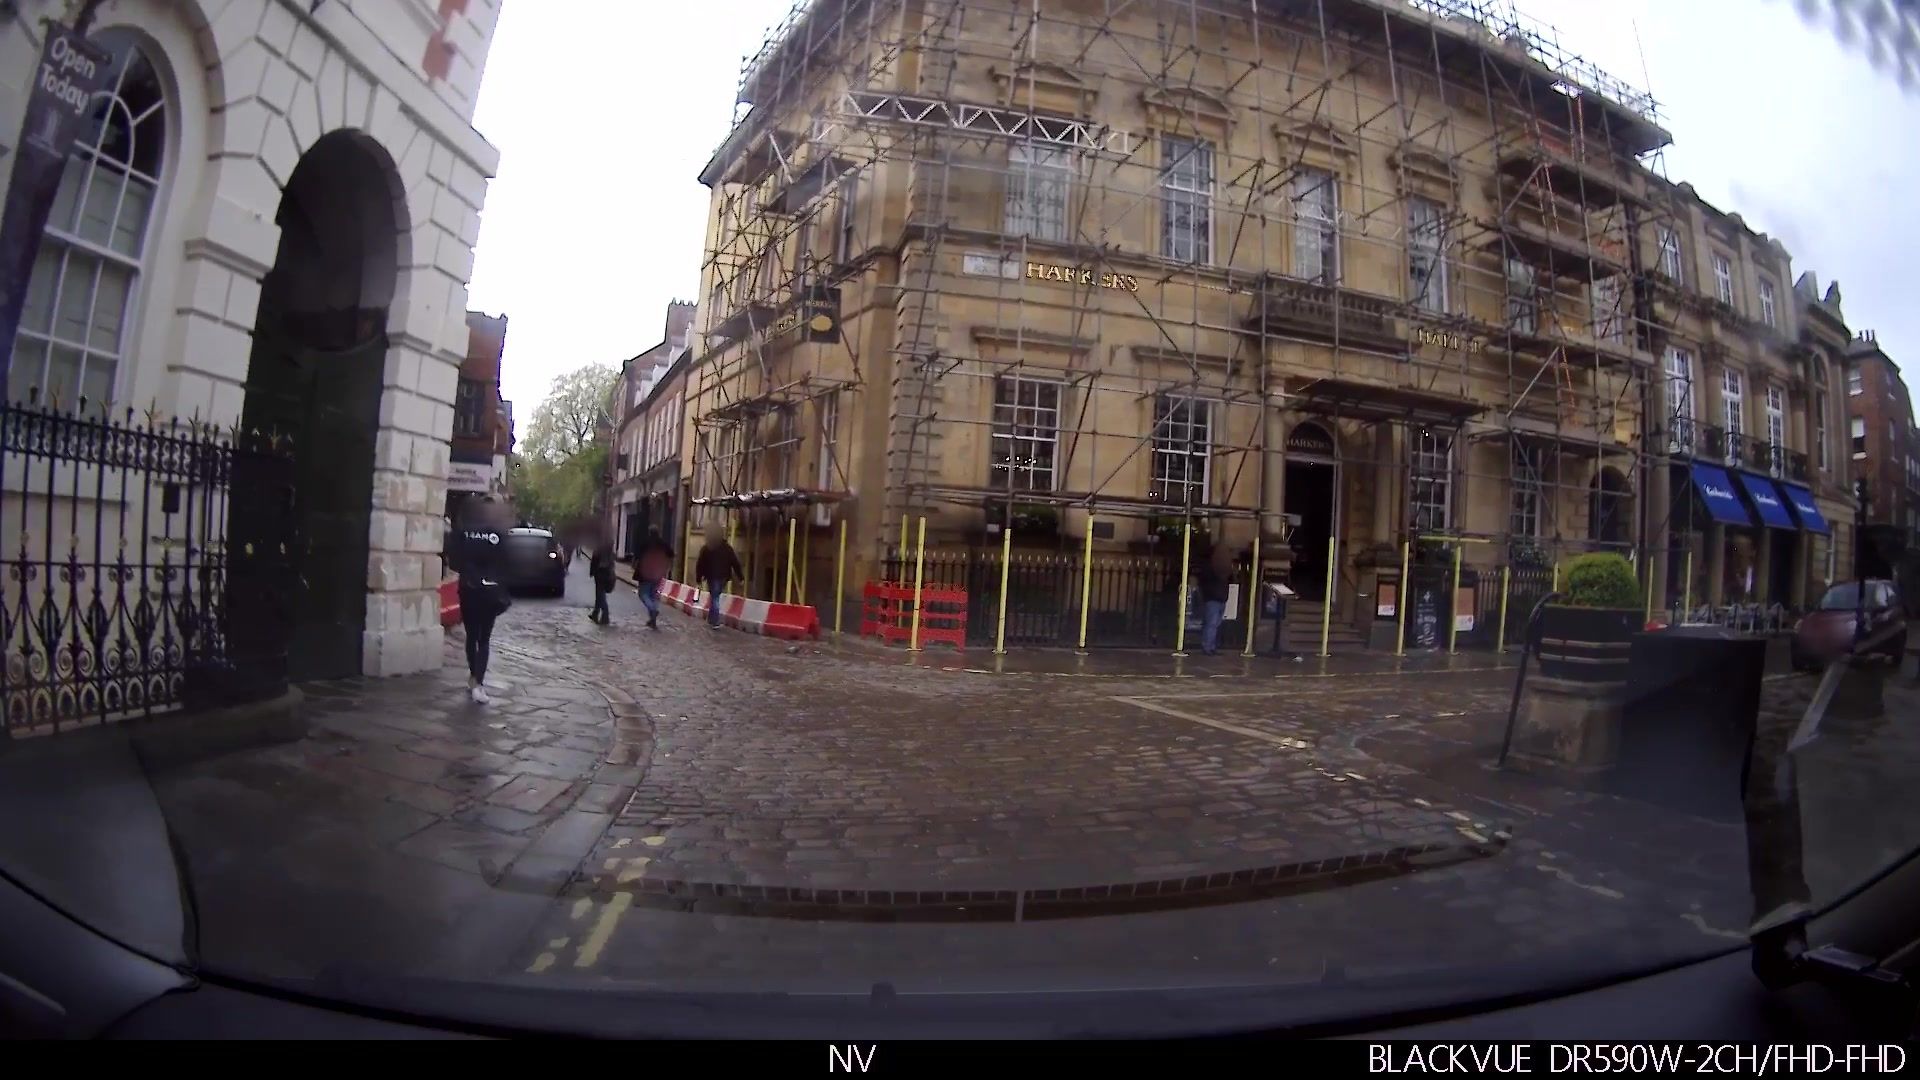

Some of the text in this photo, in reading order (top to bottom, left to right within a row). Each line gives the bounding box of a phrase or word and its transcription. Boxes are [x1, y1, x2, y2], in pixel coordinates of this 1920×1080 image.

[51, 37, 96, 80] Open
[41, 63, 89, 115] Today
[1026, 262, 1139, 292] HARKERS
